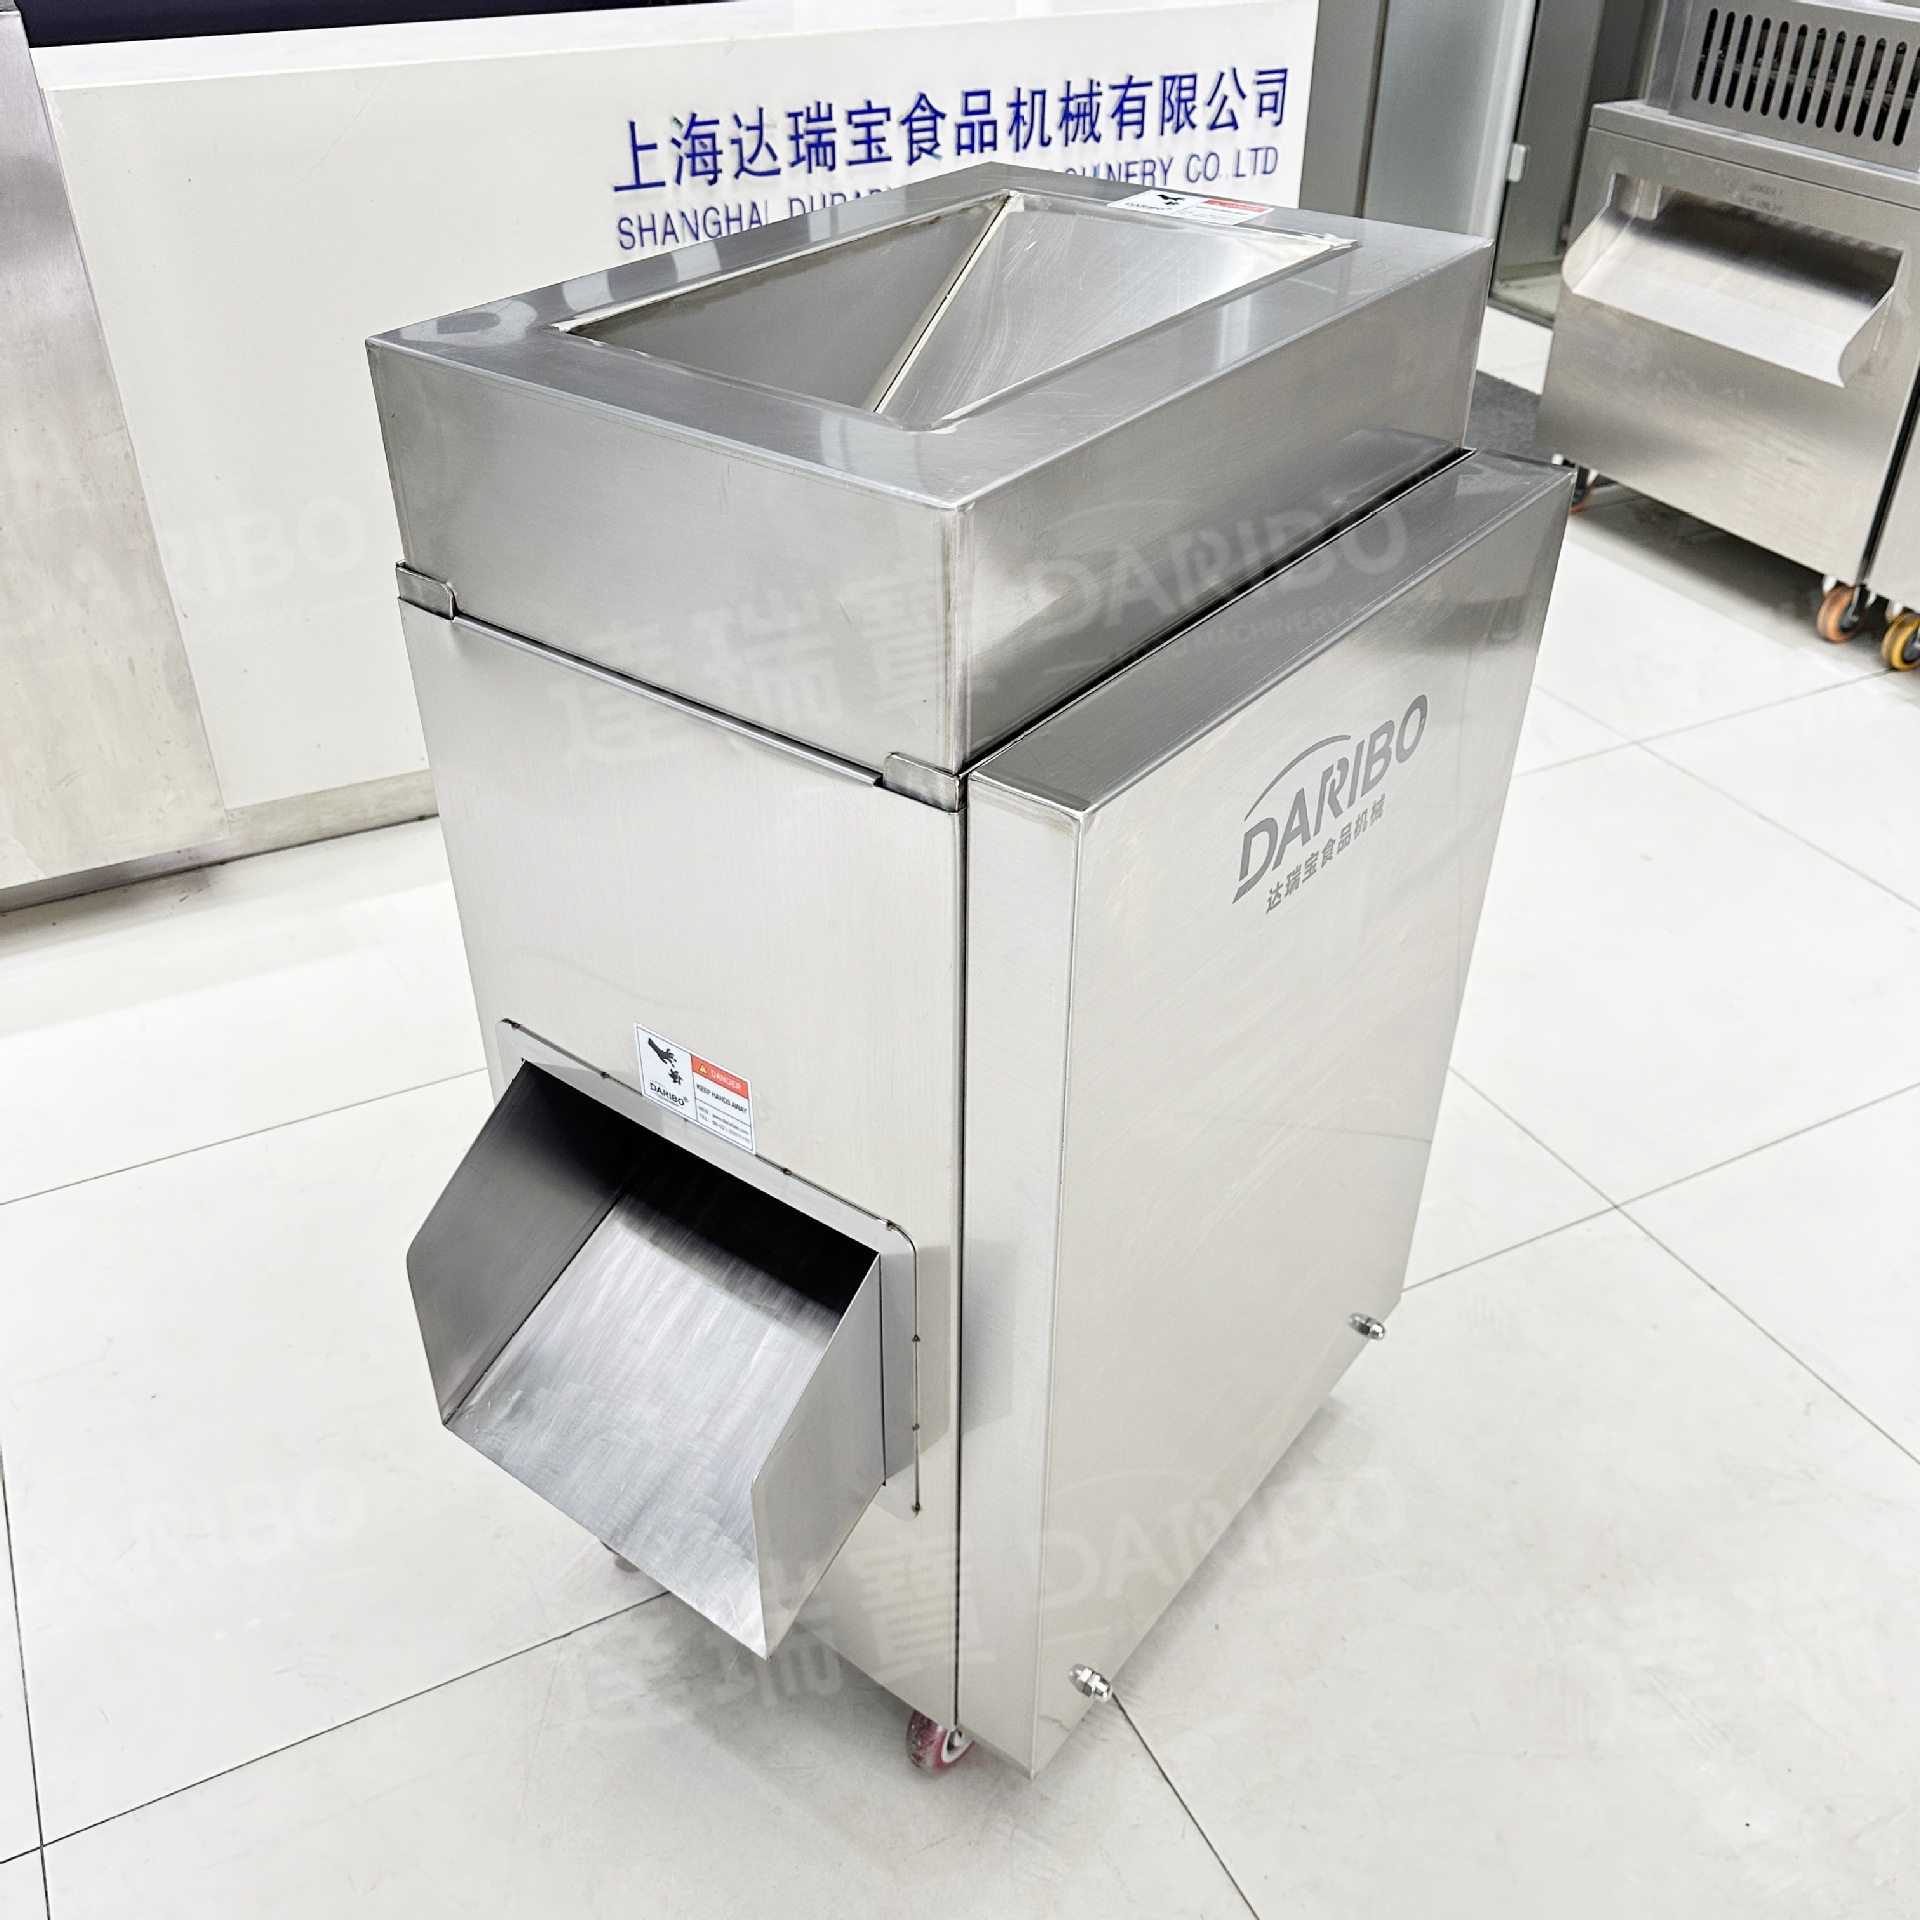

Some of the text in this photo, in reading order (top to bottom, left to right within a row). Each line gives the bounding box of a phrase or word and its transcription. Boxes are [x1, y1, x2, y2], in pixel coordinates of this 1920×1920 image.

[612, 67, 1290, 194] 上海达瑞宝食品机械有限公司
[1232, 694, 1428, 905] DARIBO
